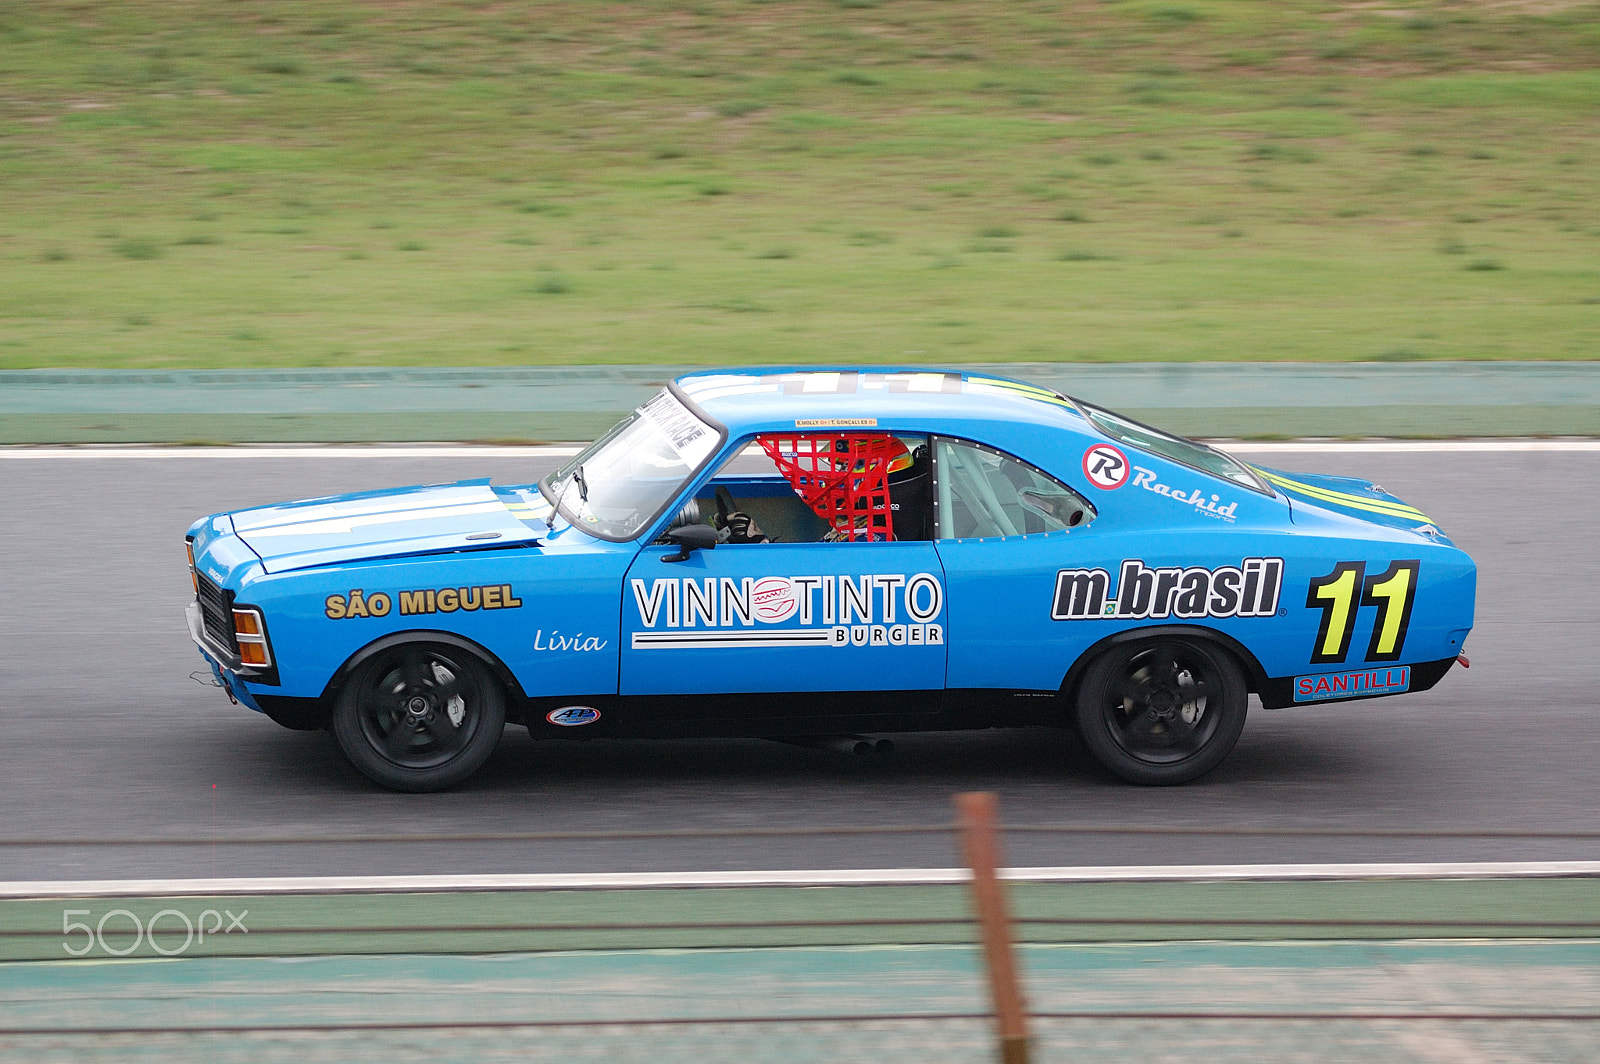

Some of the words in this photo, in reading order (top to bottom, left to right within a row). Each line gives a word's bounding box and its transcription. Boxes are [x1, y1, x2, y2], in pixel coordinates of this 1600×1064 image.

[1089, 449, 1124, 482] R
[1132, 465, 1238, 519] Rachid
[325, 588, 393, 620] SÃO
[398, 584, 523, 616] MIGUEL
[1305, 559, 1421, 664] 11
[832, 624, 945, 648] BURGER
[1298, 669, 1406, 695] SANTILLI
